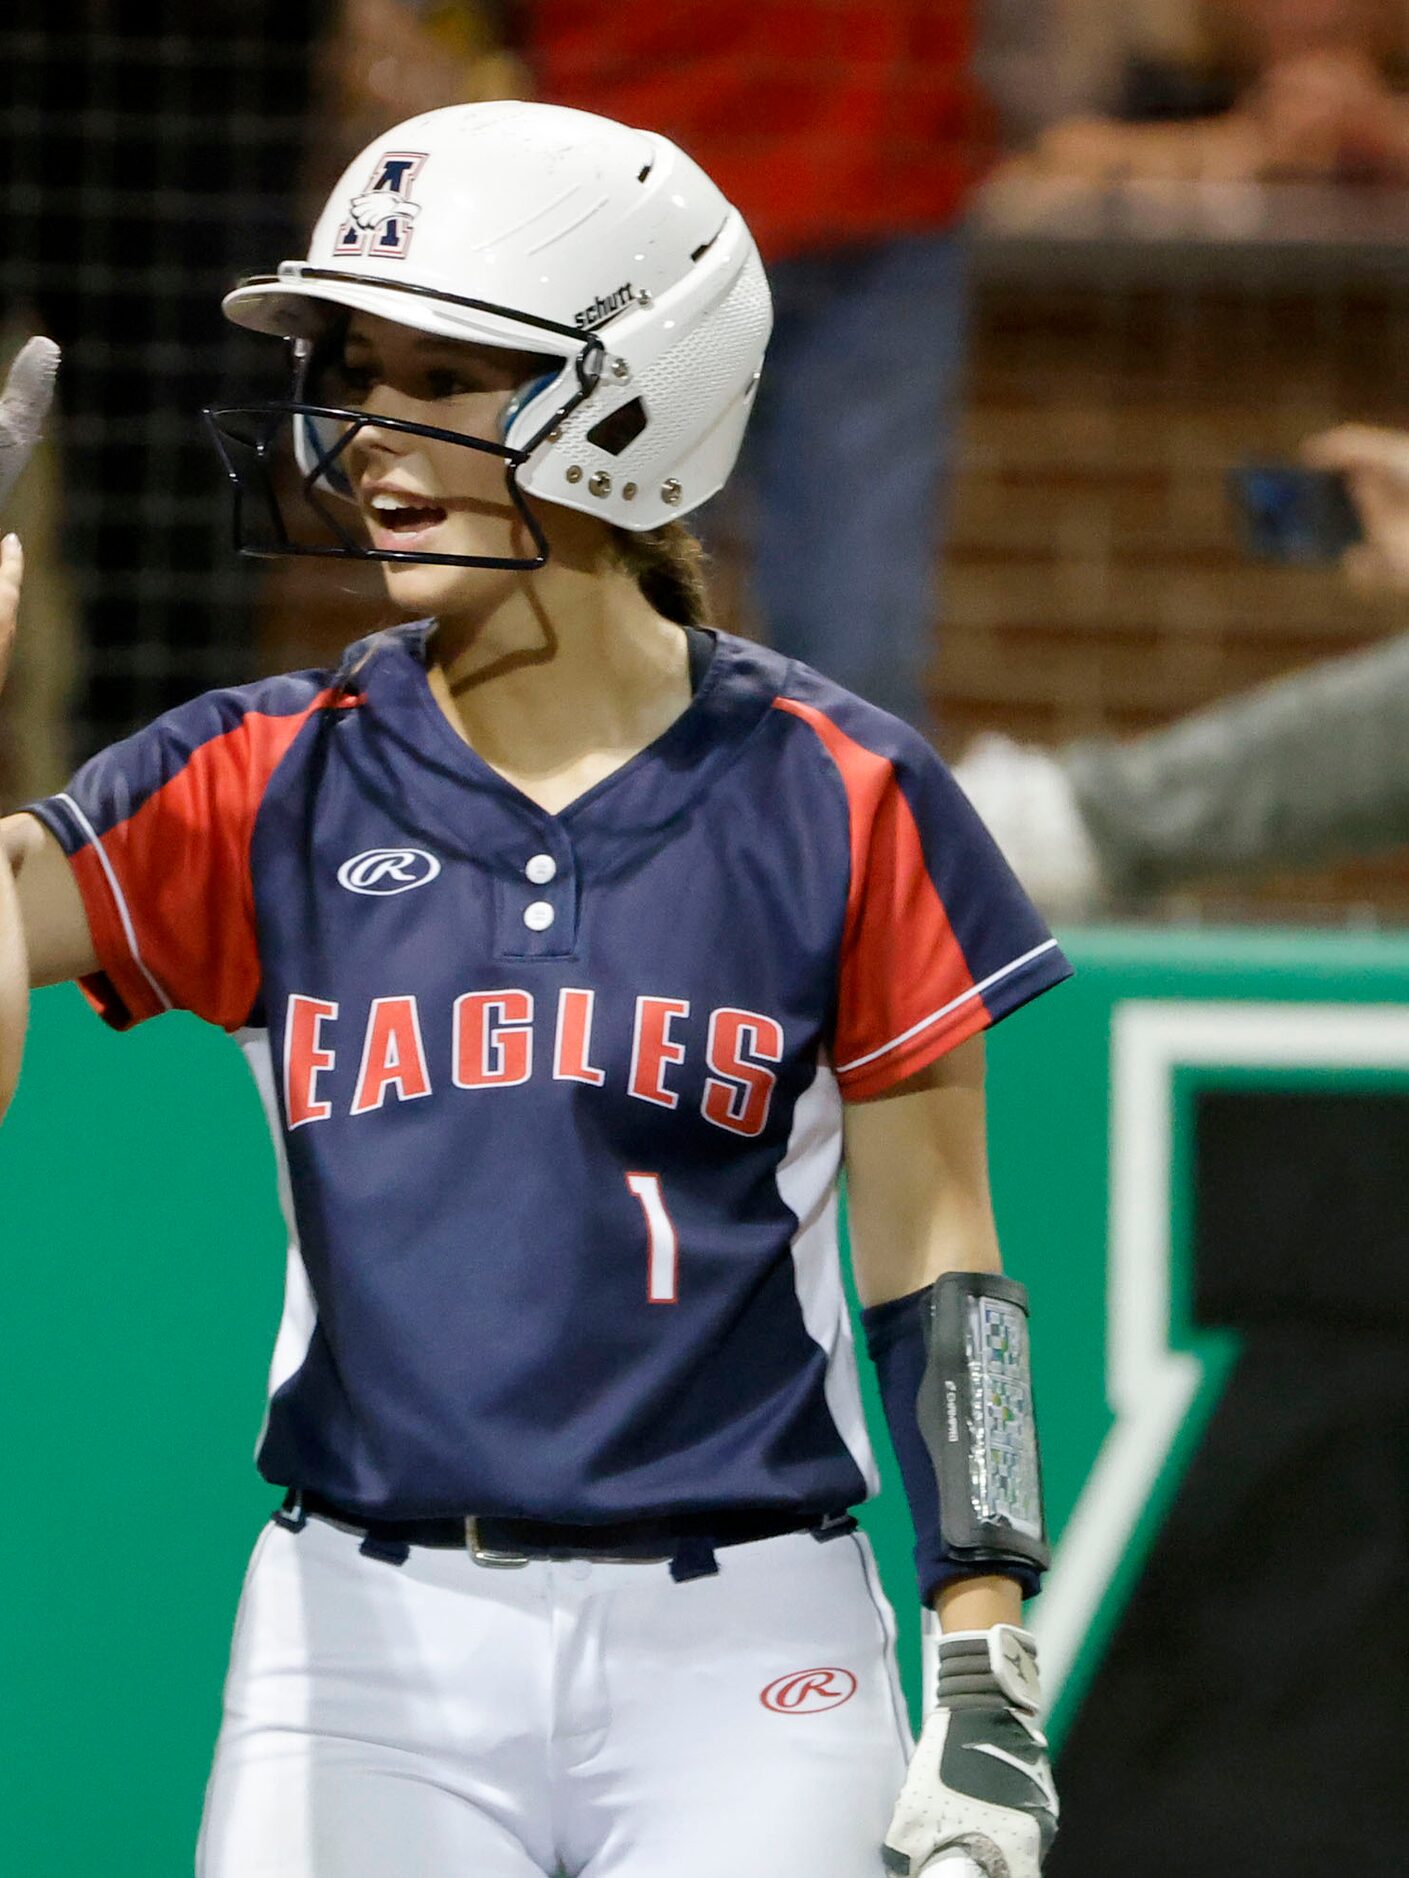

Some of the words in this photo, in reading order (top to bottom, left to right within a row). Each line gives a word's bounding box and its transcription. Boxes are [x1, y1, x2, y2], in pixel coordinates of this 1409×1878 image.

[575, 282, 635, 329] schutt
[284, 988, 784, 1138] EAGLES
[625, 1171, 678, 1304] 1
